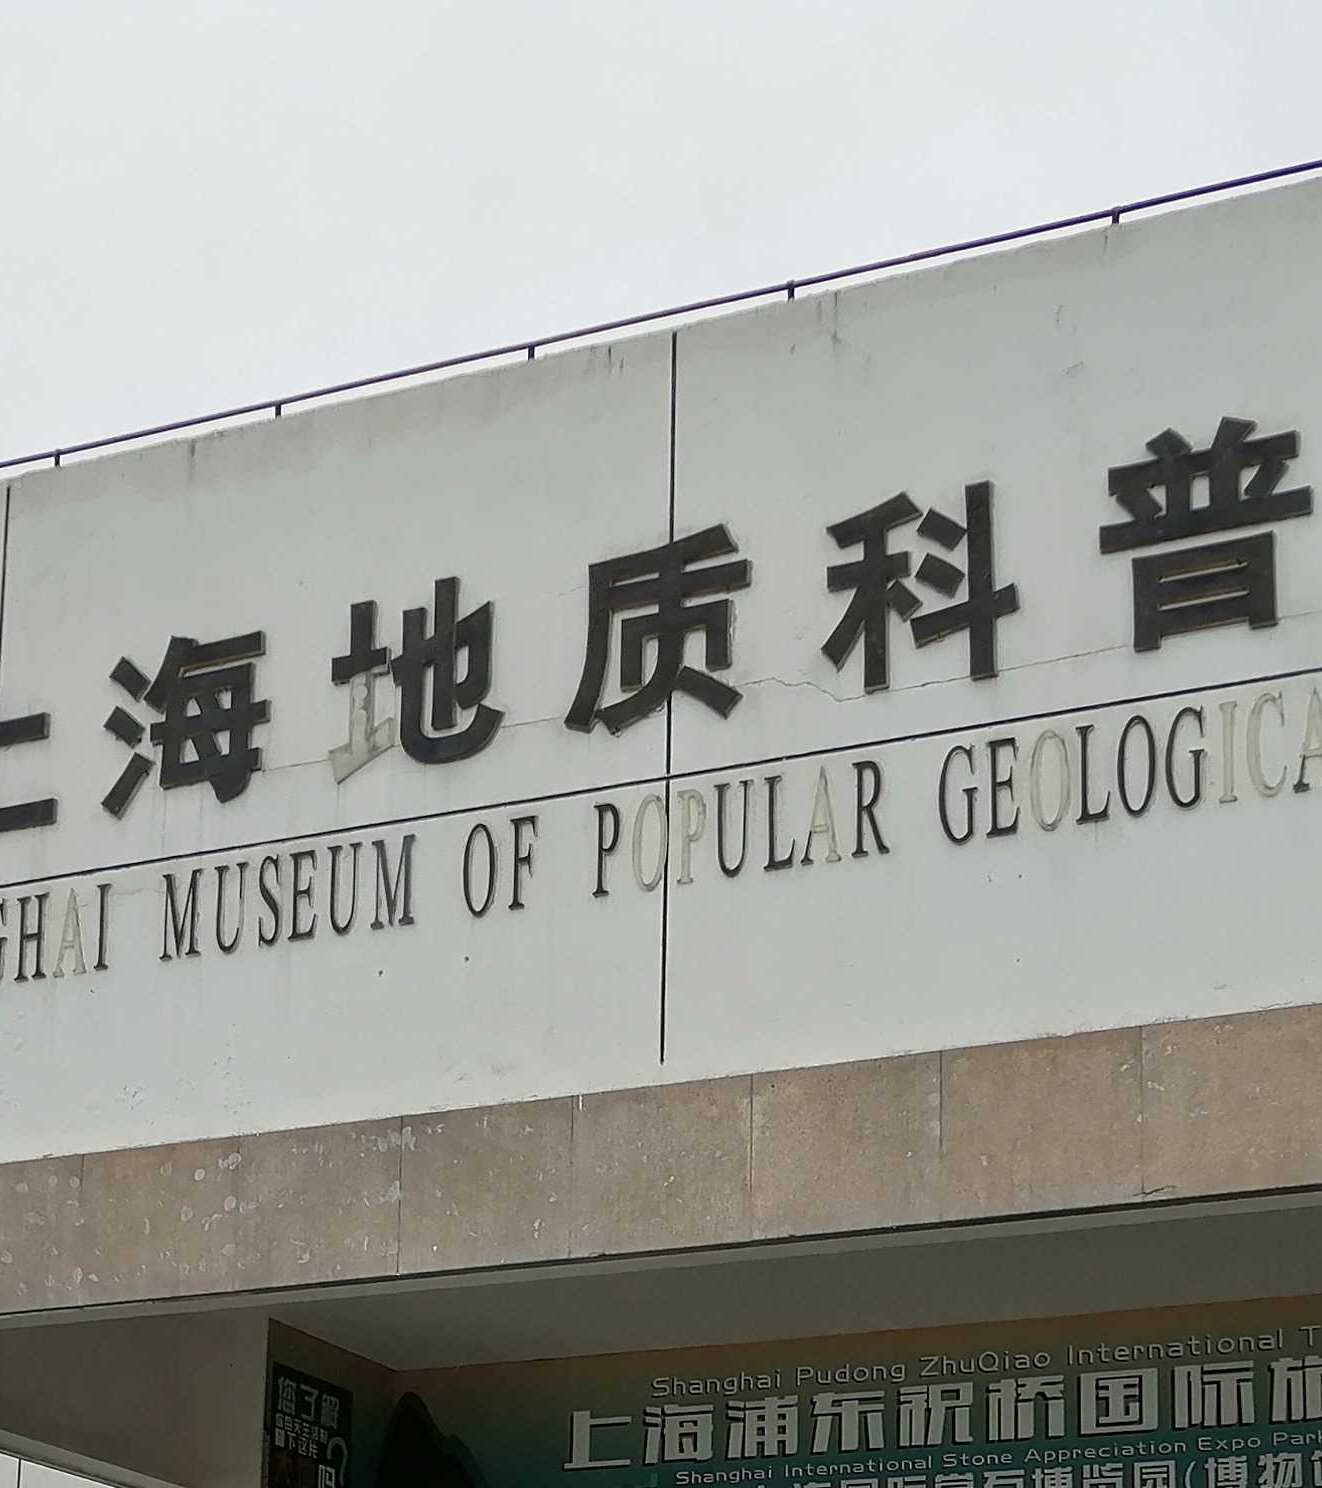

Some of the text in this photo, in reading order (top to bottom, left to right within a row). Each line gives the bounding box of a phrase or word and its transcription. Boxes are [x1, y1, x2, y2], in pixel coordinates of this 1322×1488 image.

[159, 833, 417, 961] MUSEUM
[462, 815, 539, 920] OF
[591, 759, 890, 899] POPULAR
[650, 1369, 782, 1398] Shanghai
[795, 1359, 907, 1387] Pudong
[918, 1349, 1052, 1378] ZhuQiao
[1066, 1330, 1284, 1367] International
[674, 1464, 774, 1486] Shanghai
[783, 1455, 933, 1478] International
[942, 1450, 1014, 1470] Stone
[1023, 1438, 1187, 1466] Appreciation
[1197, 1434, 1262, 1455] Expo
